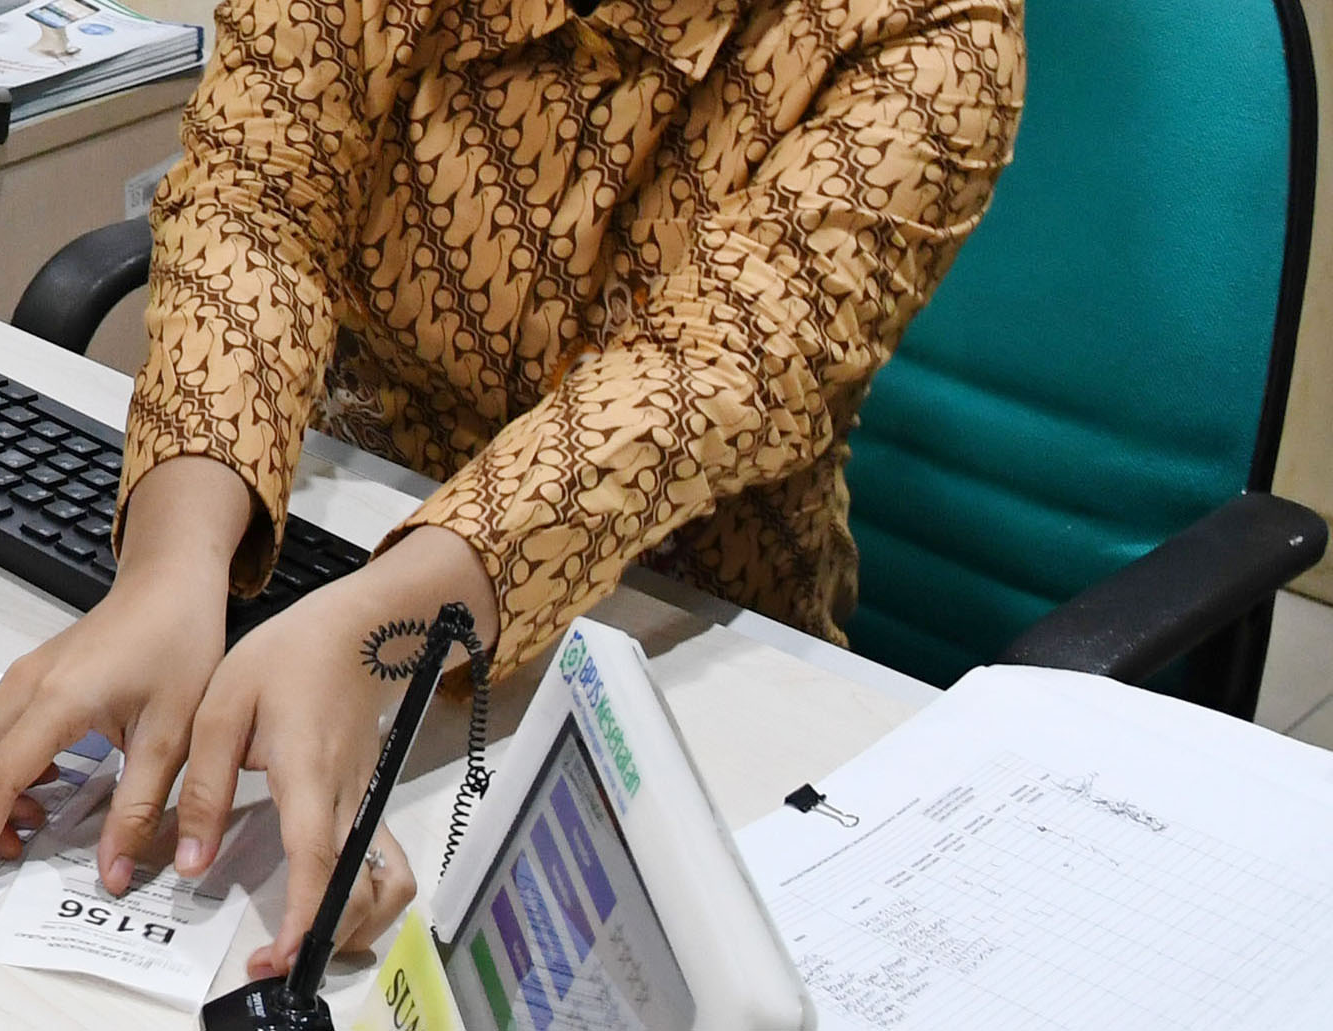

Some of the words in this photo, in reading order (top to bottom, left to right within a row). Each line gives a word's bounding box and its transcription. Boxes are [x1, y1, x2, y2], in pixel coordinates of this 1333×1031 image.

[579, 656, 604, 708] BPJS
[595, 693, 641, 799] Kesehatan
[57, 899, 176, 945] B156
